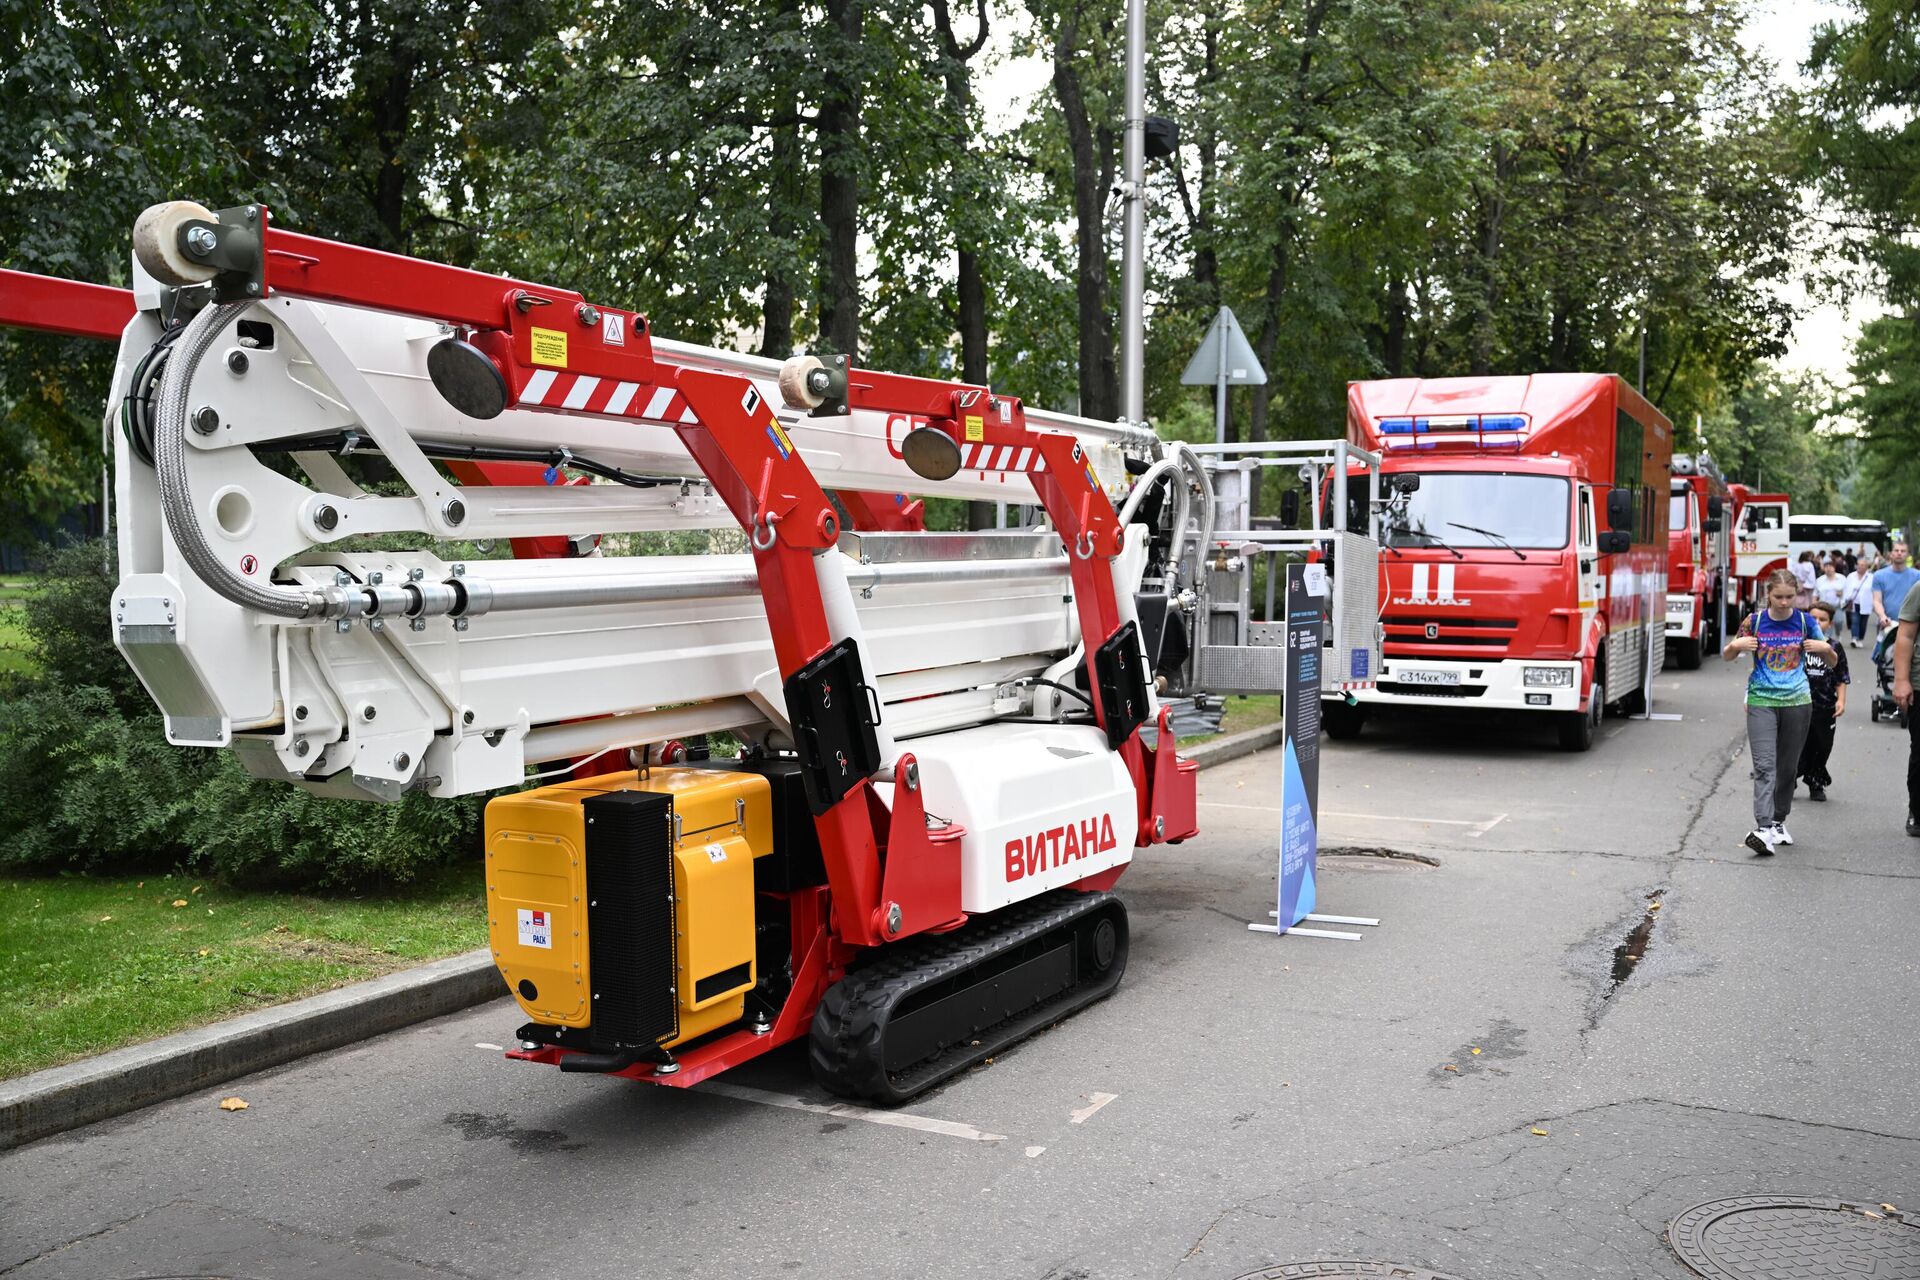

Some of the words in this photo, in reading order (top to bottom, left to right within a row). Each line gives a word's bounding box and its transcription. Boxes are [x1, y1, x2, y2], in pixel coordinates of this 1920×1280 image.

[746, 390, 758, 411] 1
[1073, 443, 1081, 460] 3
[1742, 541, 1757, 552] 89
[1442, 672, 1458, 681] 799
[1005, 813, 1117, 883] ВИТАНД
[532, 935, 546, 945] PACK
